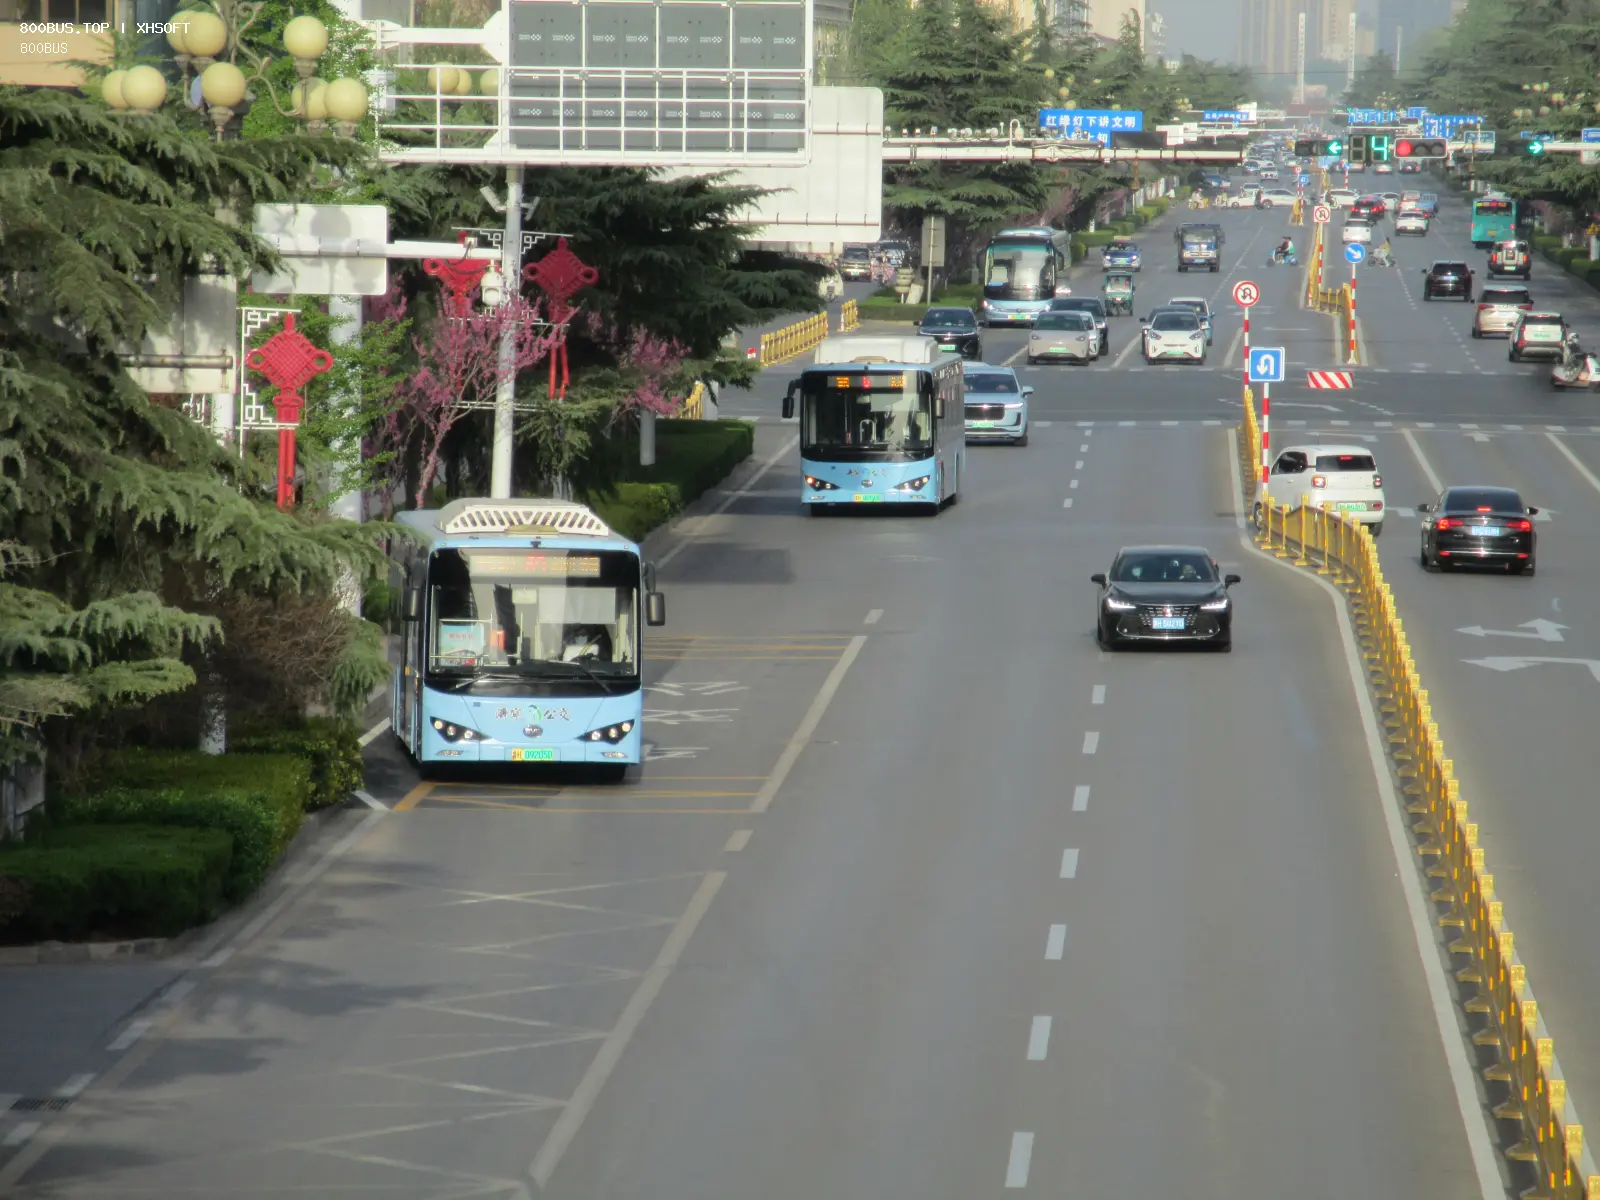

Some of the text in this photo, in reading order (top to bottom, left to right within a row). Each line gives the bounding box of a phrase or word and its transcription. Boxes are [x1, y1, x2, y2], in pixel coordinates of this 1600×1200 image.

[1045, 114, 1136, 129] 红绿灯下讲文明
[1371, 135, 1388, 161] 4
